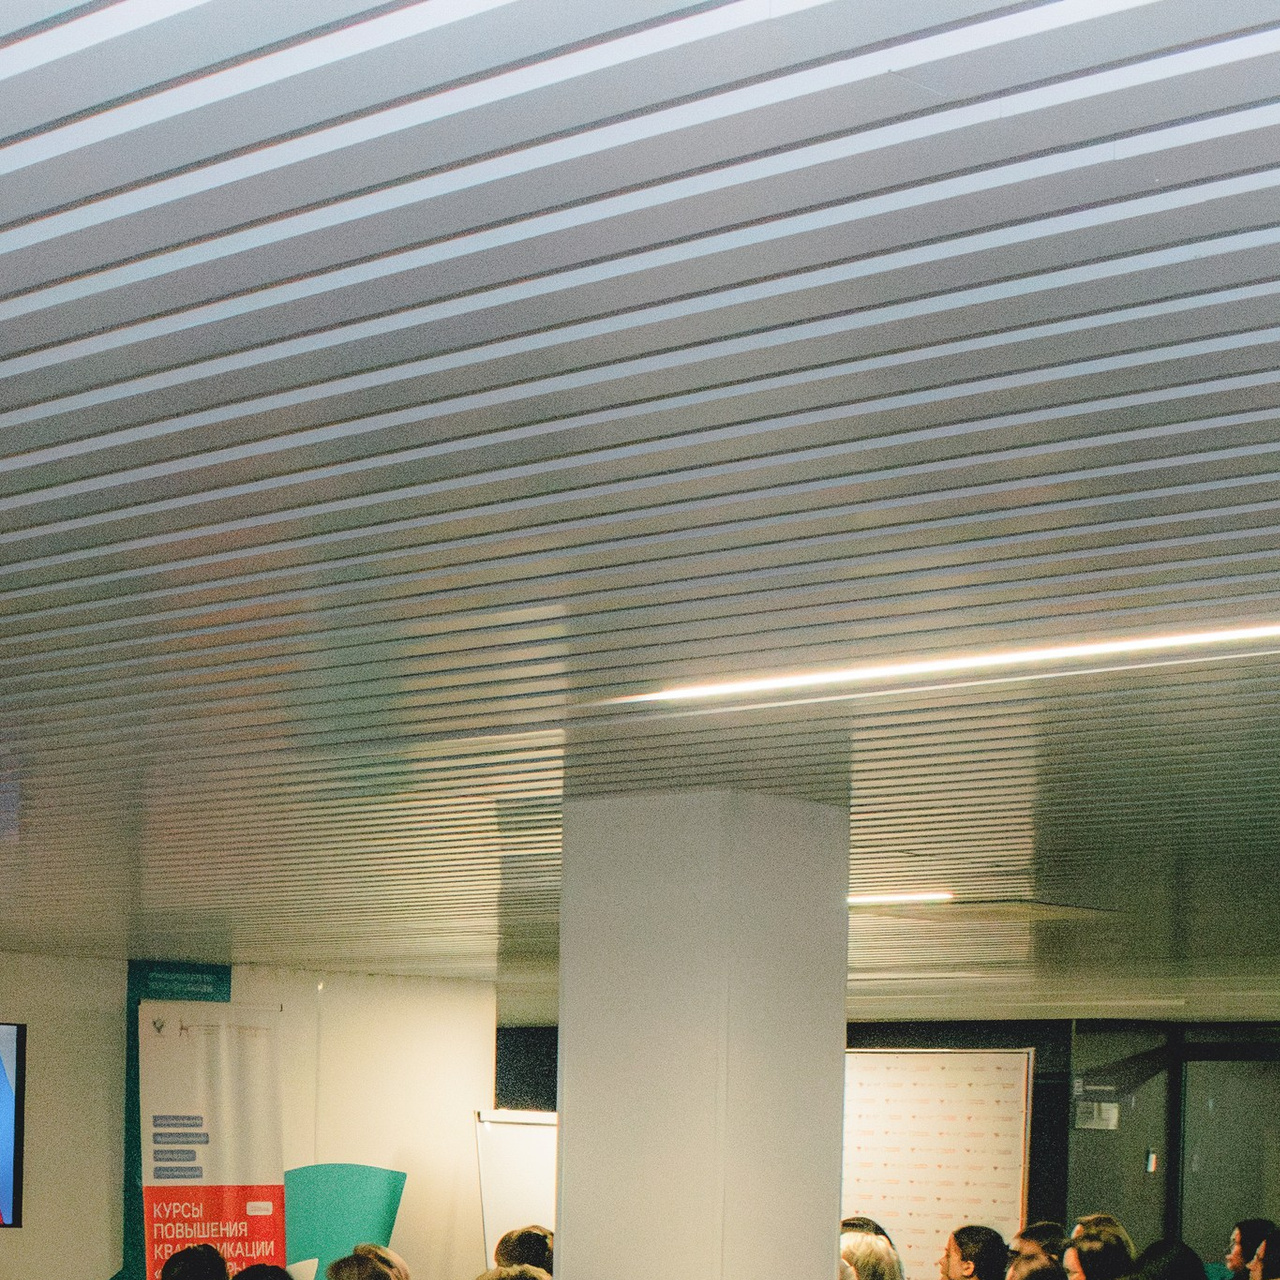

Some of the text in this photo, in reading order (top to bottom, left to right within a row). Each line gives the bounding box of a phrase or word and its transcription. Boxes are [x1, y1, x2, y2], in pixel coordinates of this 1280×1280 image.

[153, 1202, 203, 1218] КУРСЫ
[153, 1221, 248, 1239] ПОВЫШЕНИЯ
[153, 1241, 275, 1260] КВИКАЦИИ
